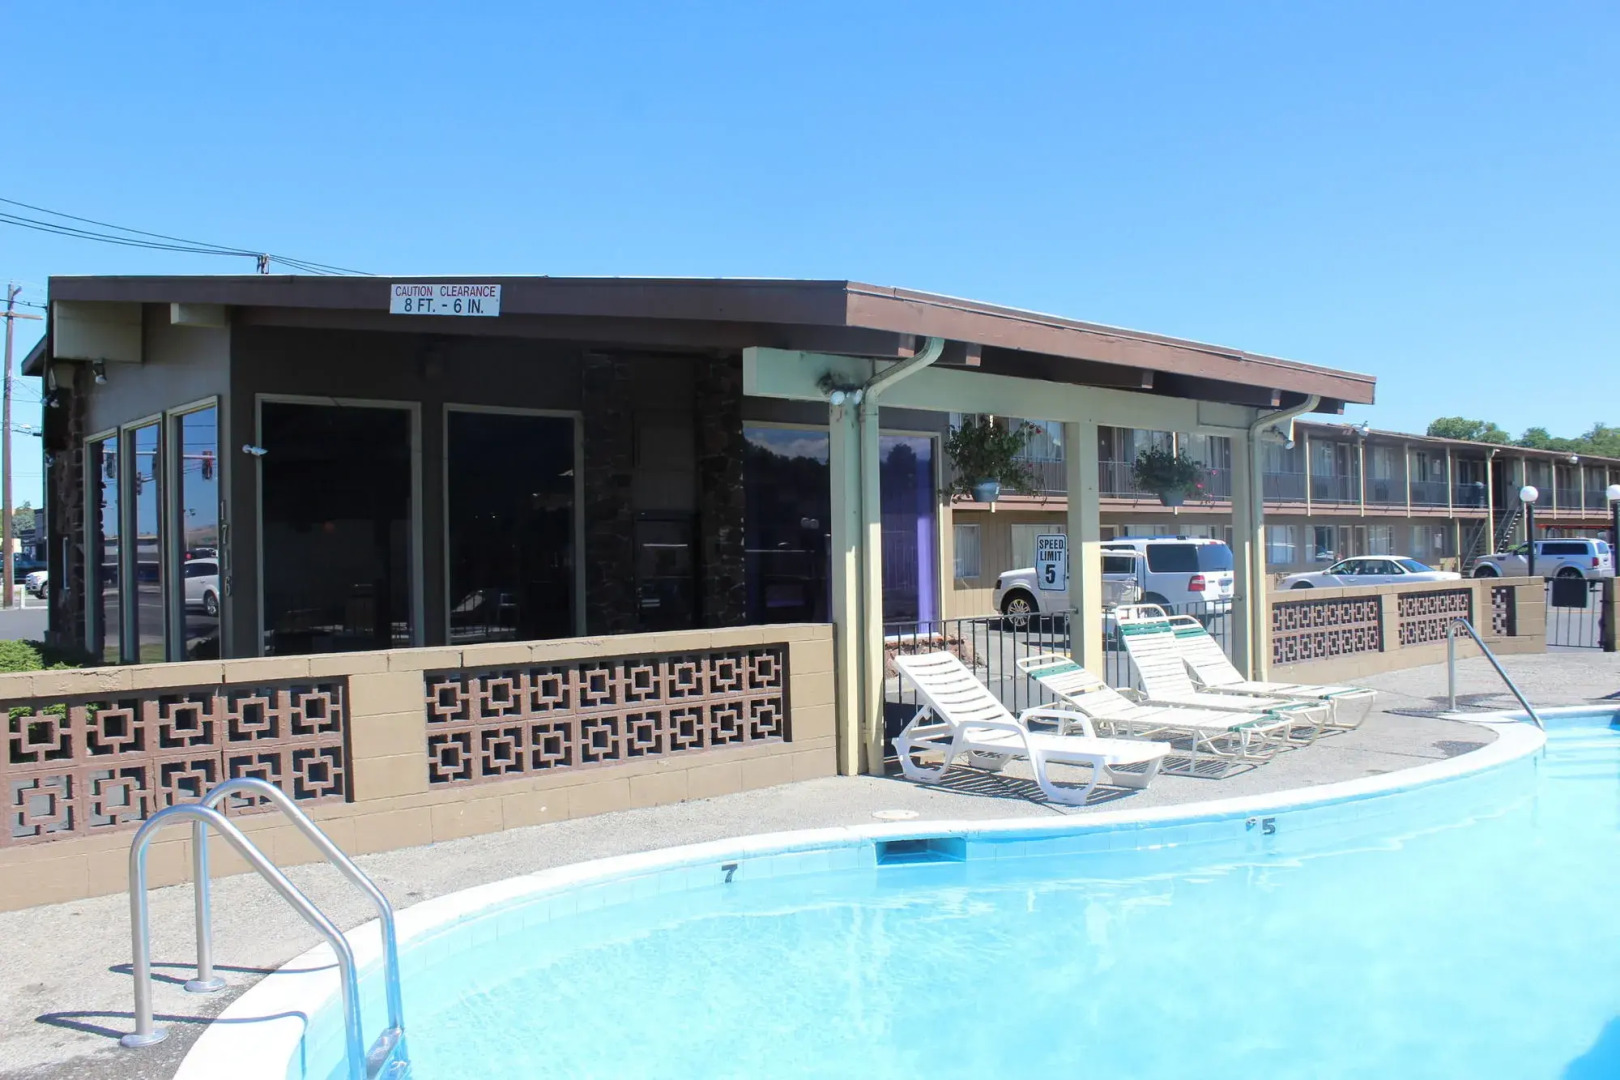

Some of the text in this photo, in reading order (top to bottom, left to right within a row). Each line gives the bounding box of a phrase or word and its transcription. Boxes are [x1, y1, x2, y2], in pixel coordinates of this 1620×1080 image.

[395, 285, 496, 298] CAUTION CLEARANCE
[404, 297, 413, 312] 8
[417, 298, 436, 313] FT.
[453, 298, 462, 314] 6
[467, 298, 484, 314] IN.
[1039, 539, 1064, 550] SPEED
[1040, 550, 1062, 562] LIMIT
[1045, 563, 1056, 584] 5
[1262, 817, 1276, 835] 5
[721, 863, 738, 883] 7
